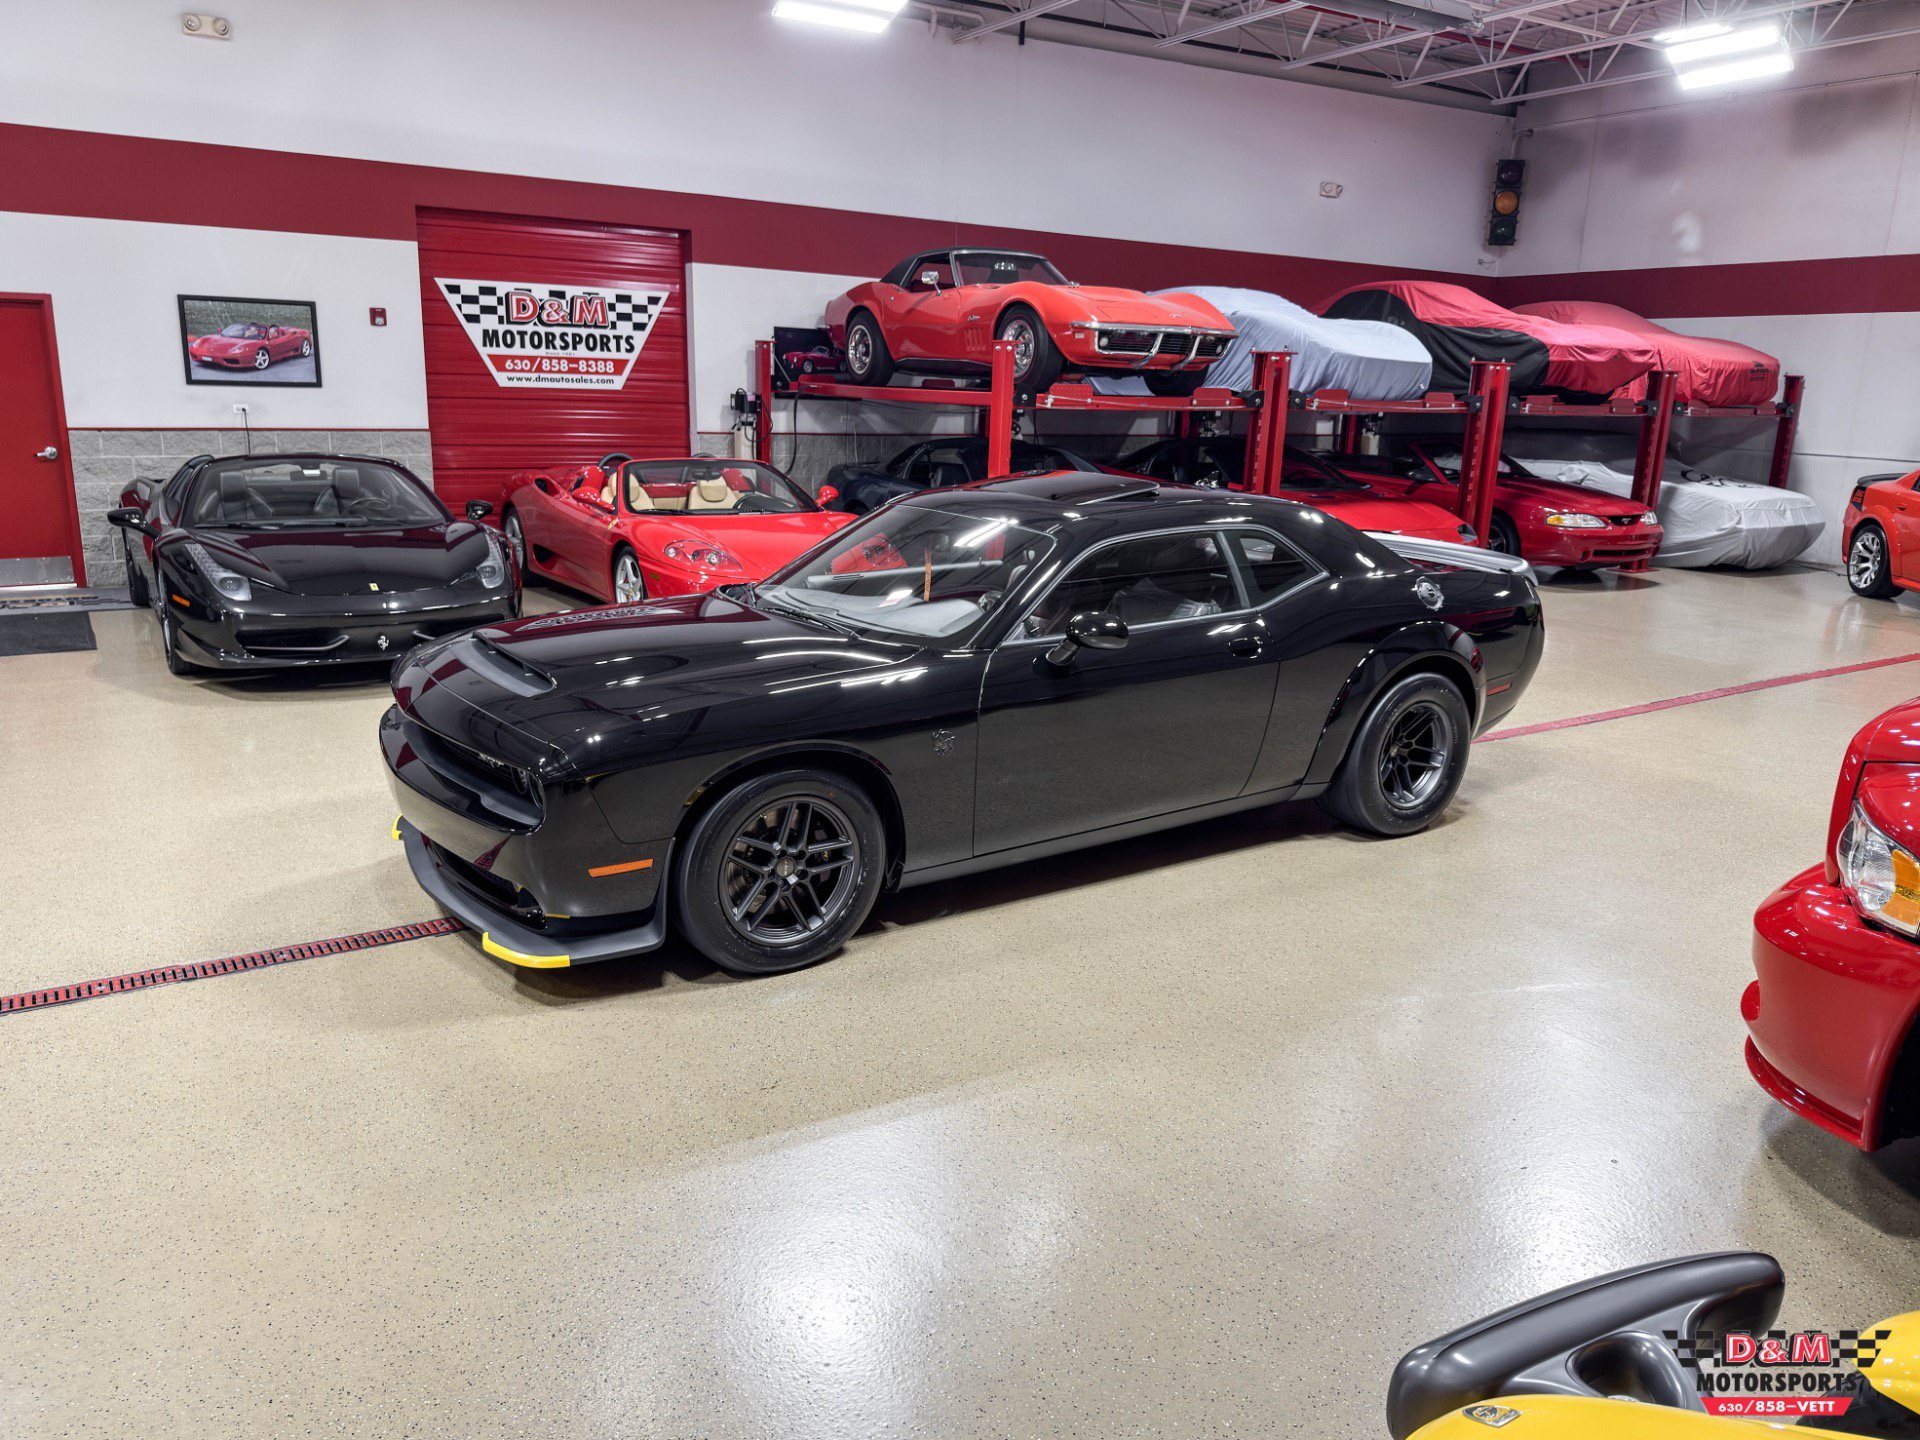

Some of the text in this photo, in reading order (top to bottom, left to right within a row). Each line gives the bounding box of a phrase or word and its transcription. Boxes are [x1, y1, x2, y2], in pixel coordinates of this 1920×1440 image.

[505, 291, 609, 327] D&M
[482, 328, 635, 353] MOTORSPORTS
[505, 358, 615, 373] 630/858-8388
[506, 374, 615, 385] www.dmautosales.com
